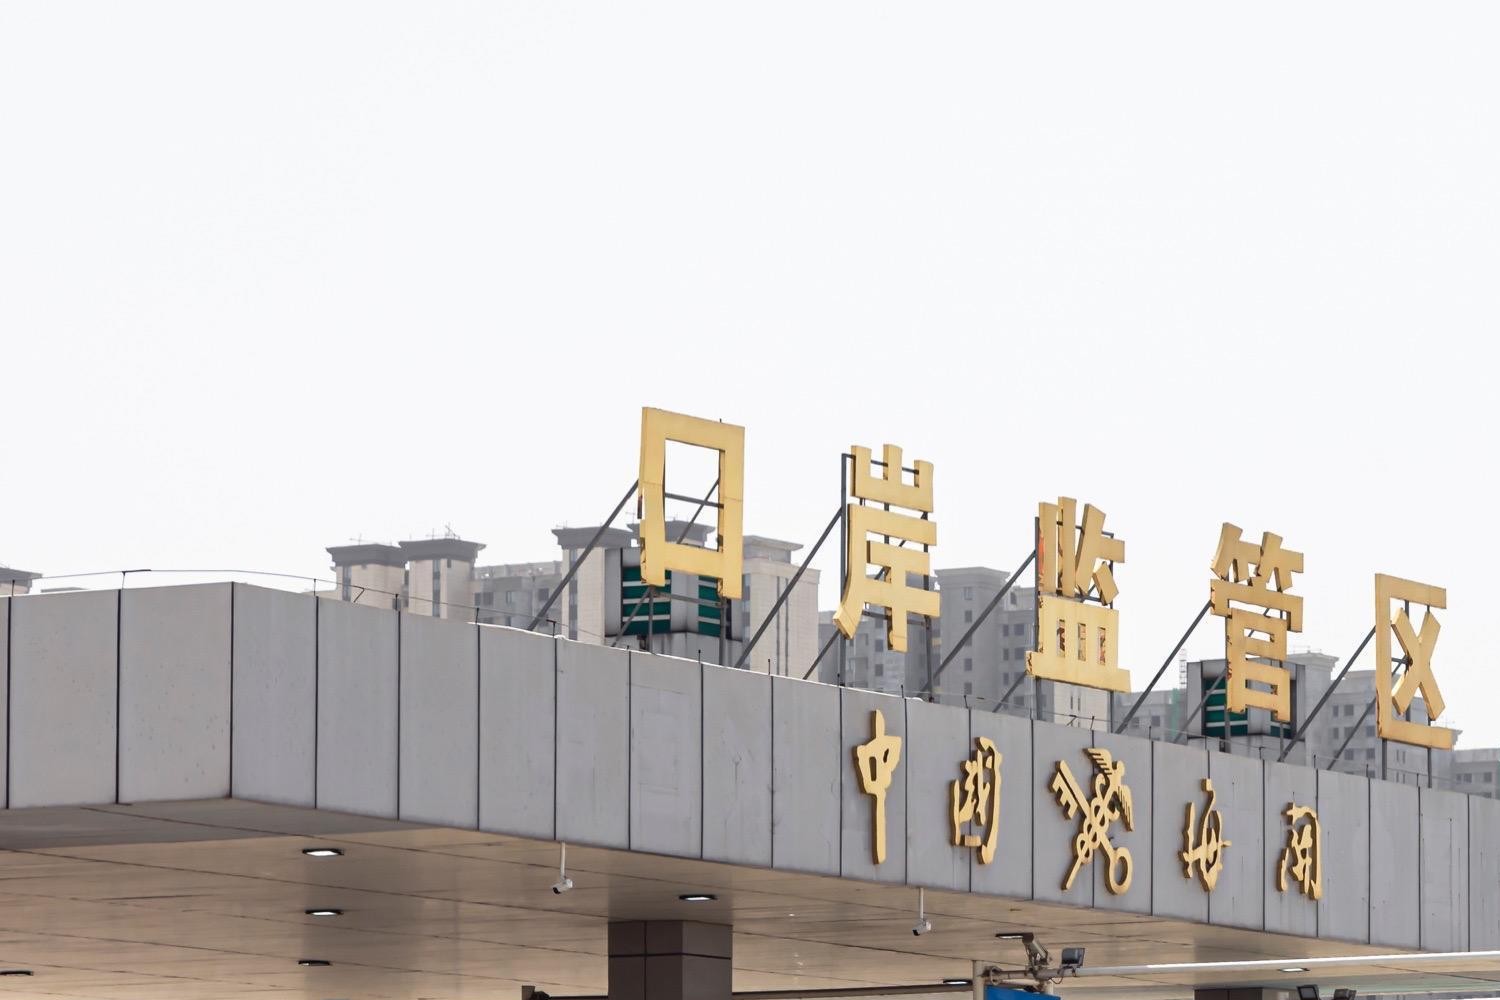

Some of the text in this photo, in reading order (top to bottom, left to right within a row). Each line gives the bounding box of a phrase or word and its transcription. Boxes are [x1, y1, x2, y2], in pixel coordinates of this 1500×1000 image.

[638, 406, 1454, 750] 口岸监管区
